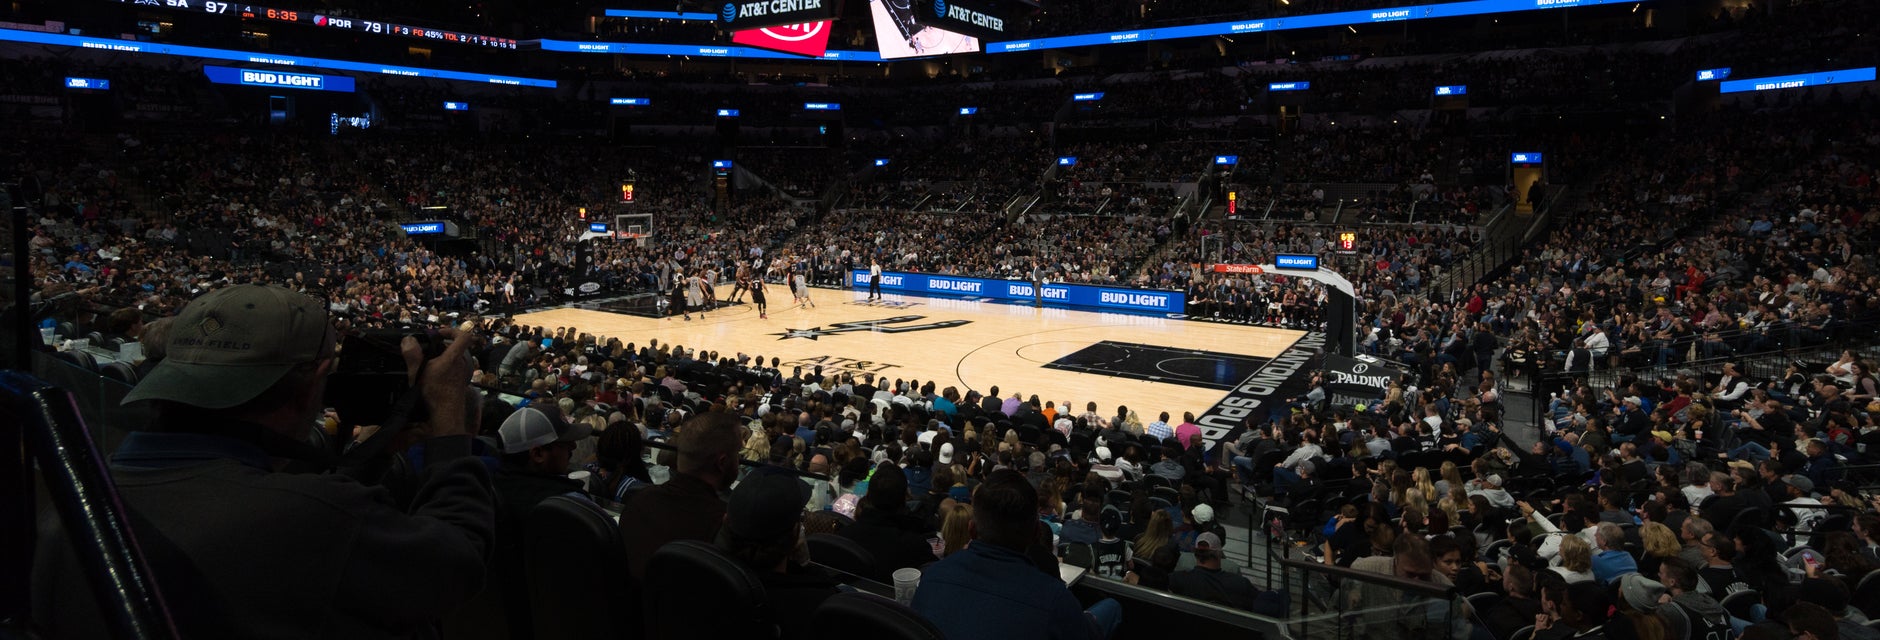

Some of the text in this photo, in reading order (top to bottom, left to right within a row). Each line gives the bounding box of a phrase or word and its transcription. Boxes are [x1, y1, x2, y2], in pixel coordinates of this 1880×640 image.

[166, 0, 228, 14] SA 97
[739, 0, 821, 19] AT&T CENTER
[266, 9, 298, 21] 6:35
[948, 4, 1004, 32] AT&T CENTER
[1372, 10, 1410, 20] BUD LIGHT
[328, 18, 352, 29] POR
[363, 21, 382, 33] 79
[394, 25, 401, 34] F
[402, 27, 409, 35] 3
[412, 28, 424, 37] FG
[425, 30, 444, 40] 45%
[444, 33, 459, 41] TOL
[243, 72, 321, 87] BUD LIGHT
[1755, 80, 1805, 91] BUD LIGHT
[624, 191, 633, 200] 13
[1343, 240, 1352, 249] 13
[855, 273, 903, 286] BU IGHT
[929, 279, 982, 292] BUD LIGHT
[1009, 285, 1033, 296] BUD
[1101, 292, 1167, 307] BUD LIGHT
[209, 340, 251, 351] FIELD
[1238, 348, 1315, 396] ANTONIO
